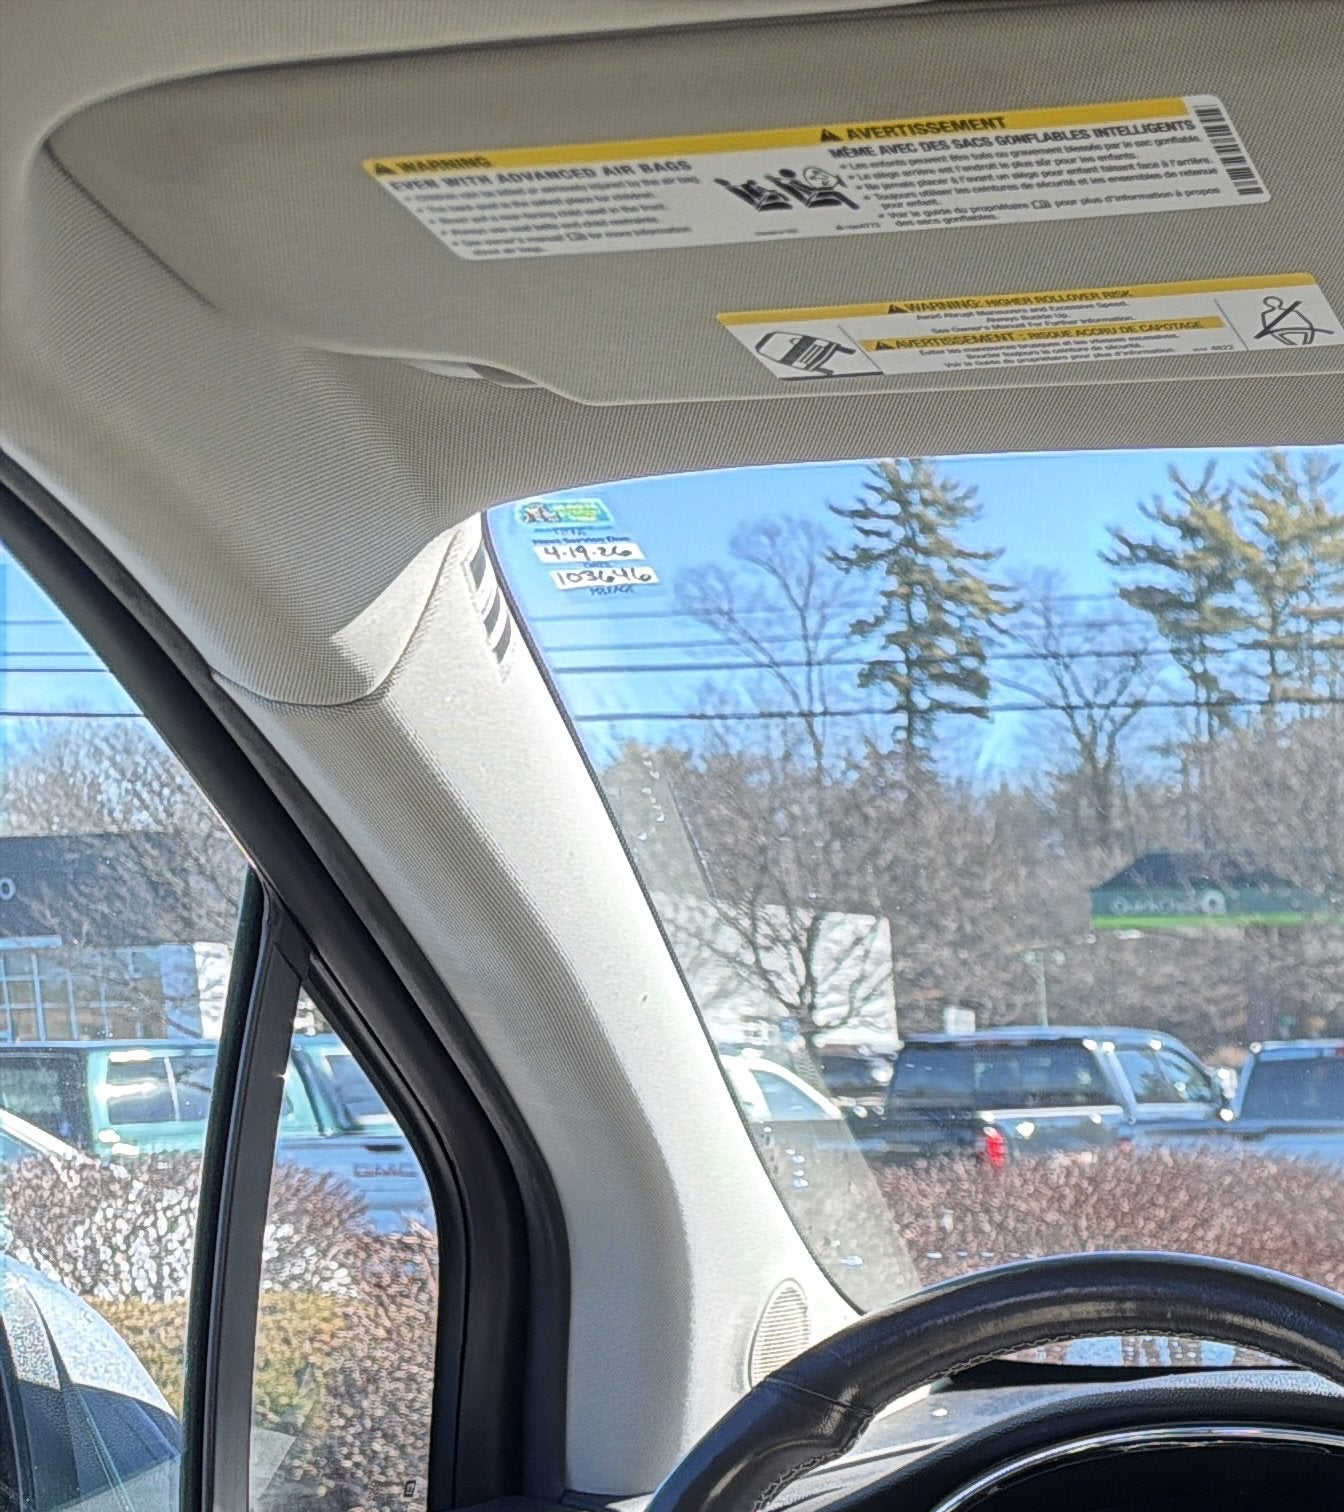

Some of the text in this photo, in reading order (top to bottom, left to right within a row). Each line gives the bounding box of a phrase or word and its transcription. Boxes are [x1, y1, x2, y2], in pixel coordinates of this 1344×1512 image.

[829, 120, 1196, 159] MÊME AVEC DES SACS GONFLABLES INTELLIGENTS
[847, 116, 1007, 140] AVERTISSEMENT
[389, 160, 692, 191] EVEN WITH ADVANCED AIR BAGS
[397, 156, 492, 173] WARNING
[986, 297, 1032, 306] HIGHER
[1033, 292, 1101, 304] ROLLOVER
[895, 321, 1205, 349] AVERTISSEMENT RISQUE ACCRU DE CAPOTAGE
[556, 567, 652, 586] 103646
